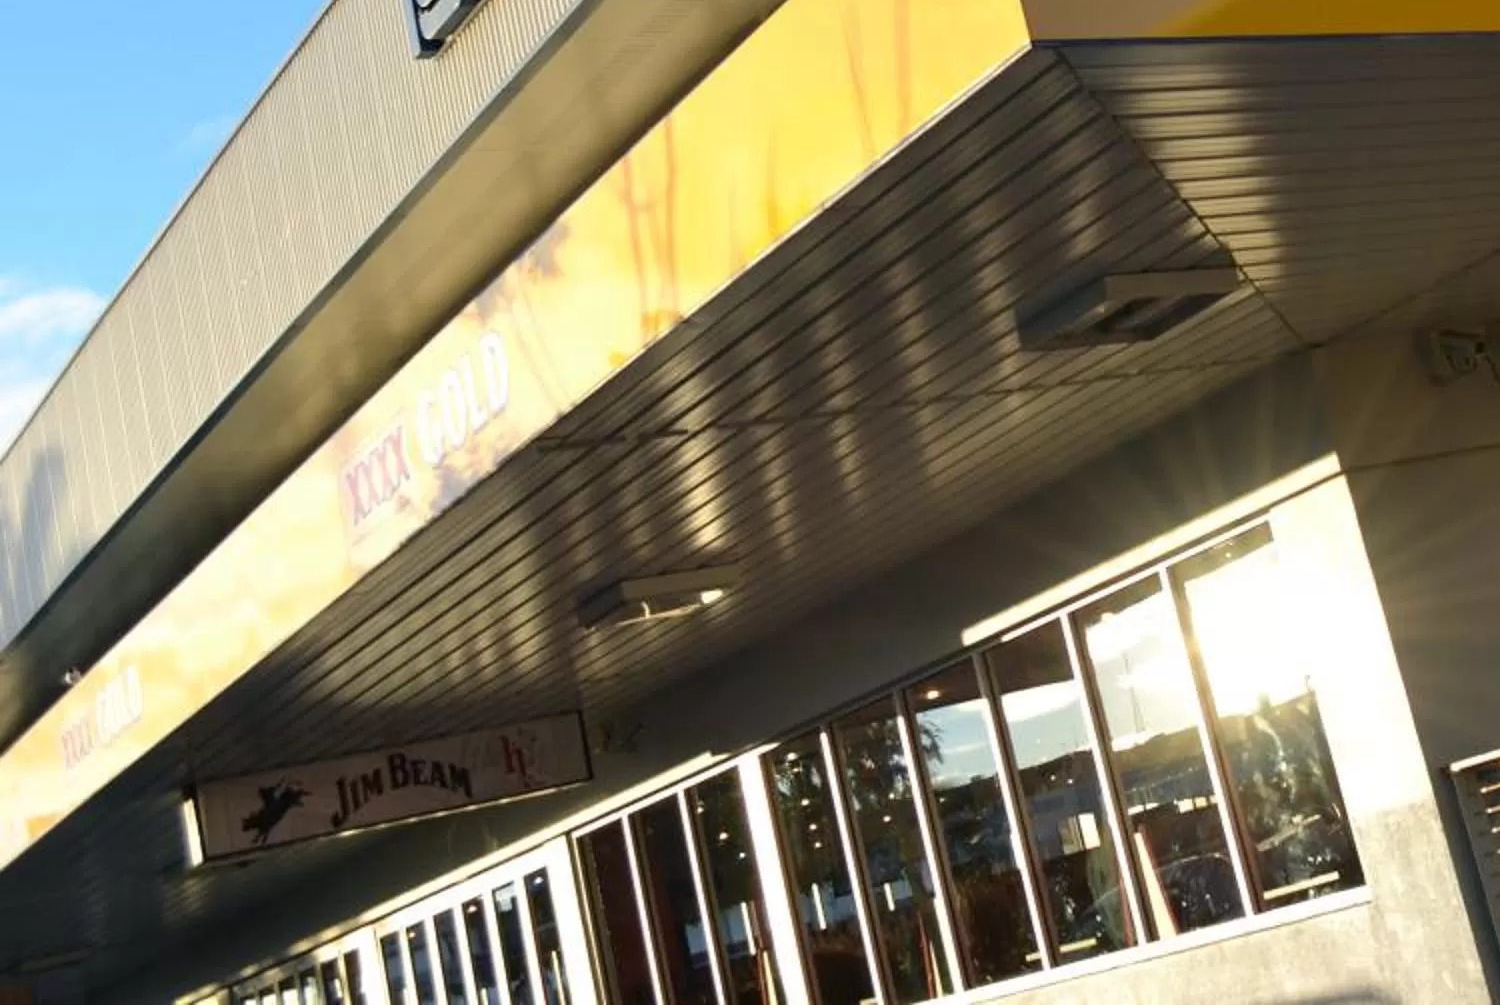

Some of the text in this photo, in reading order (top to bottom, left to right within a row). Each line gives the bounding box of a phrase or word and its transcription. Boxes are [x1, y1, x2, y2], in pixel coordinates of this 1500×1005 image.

[416, 330, 509, 470] GOLD
[330, 775, 385, 829] JIM
[387, 753, 474, 800] BEAM
